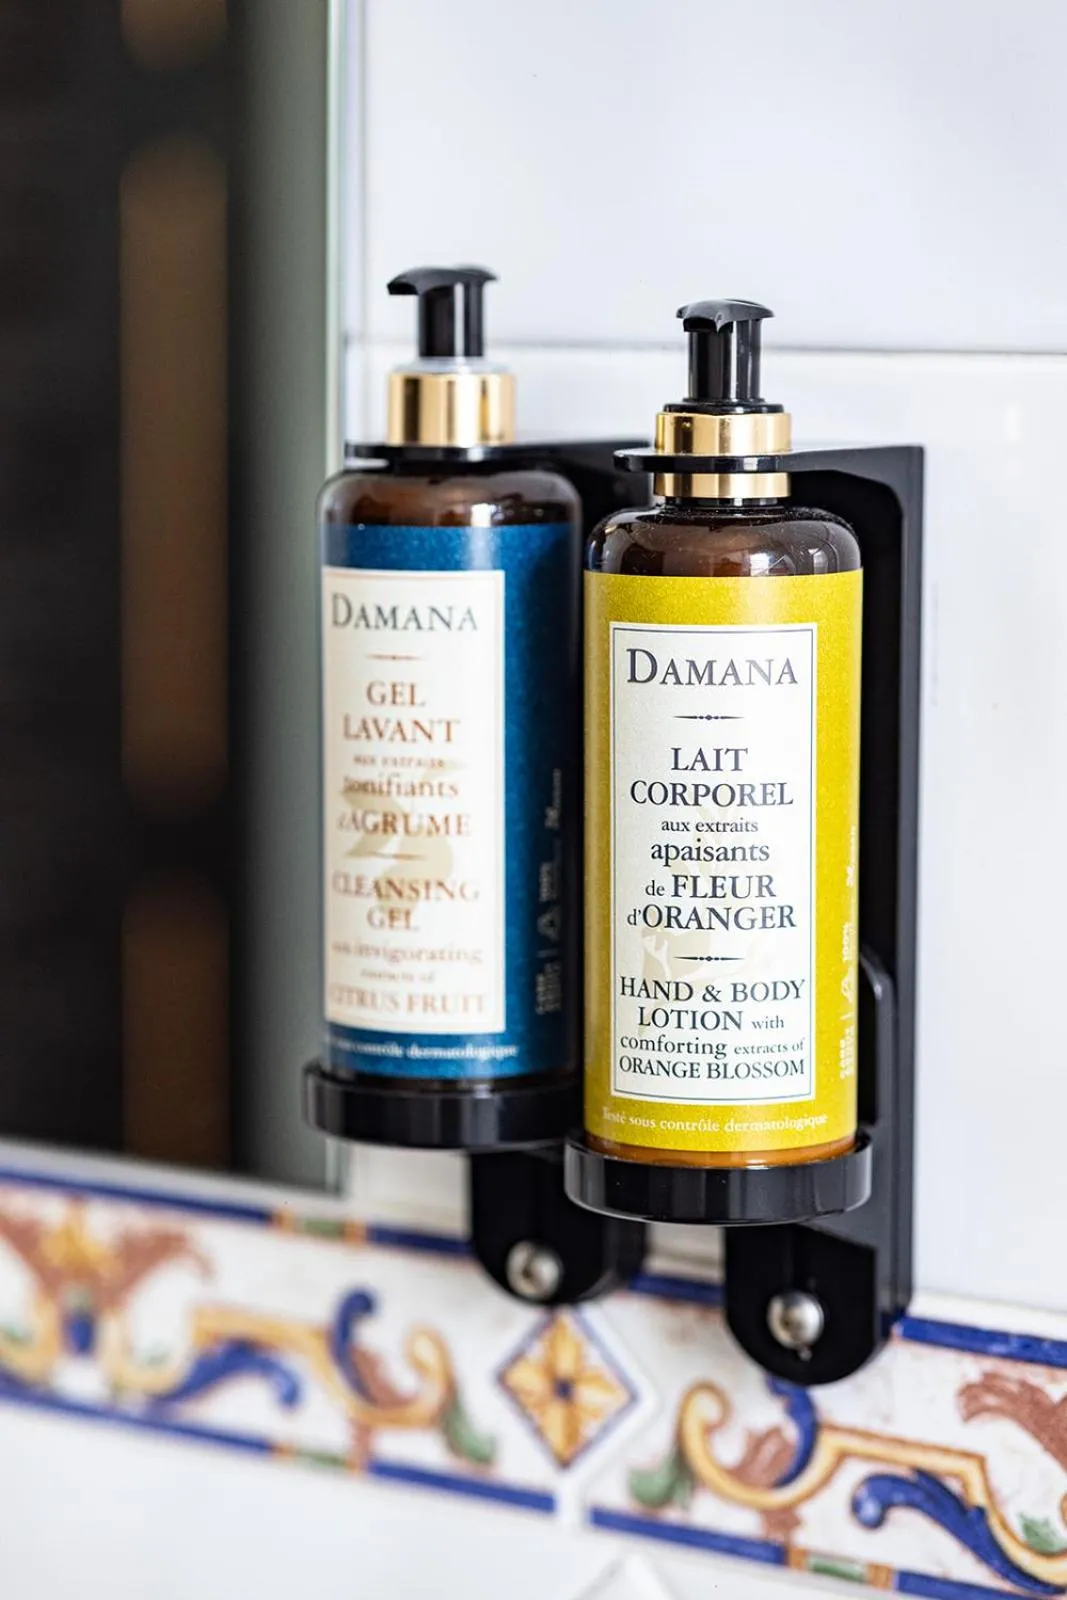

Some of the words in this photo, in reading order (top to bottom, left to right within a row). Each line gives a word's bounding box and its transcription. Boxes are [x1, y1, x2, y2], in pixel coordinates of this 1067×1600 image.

[366, 680, 426, 706] GEL
[343, 714, 461, 743] LAVANT
[671, 748, 748, 772] LAIT
[630, 781, 794, 807] CORPOREL
[661, 821, 691, 832] aux
[695, 817, 759, 833] extraits
[651, 838, 770, 867] apaisants
[332, 871, 480, 902] CLEANSING
[645, 880, 665, 897] de
[671, 874, 777, 899] FLEUR
[367, 907, 420, 931] GEL
[627, 904, 797, 931] d'ORANGER
[620, 976, 694, 1001] HAND
[702, 984, 723, 1002] &
[731, 979, 806, 1002] BODY
[638, 1006, 744, 1031] LOTION
[751, 1015, 785, 1029] with
[620, 1035, 728, 1060] comforting
[734, 1041, 788, 1055] extracts
[791, 1038, 806, 1051] of
[619, 1056, 701, 1078] ORANGE
[706, 1059, 805, 1079] BLOSSOM
[629, 1115, 656, 1129] sous
[660, 1117, 720, 1132] contrôle
[724, 1112, 829, 1134] dermatologique
